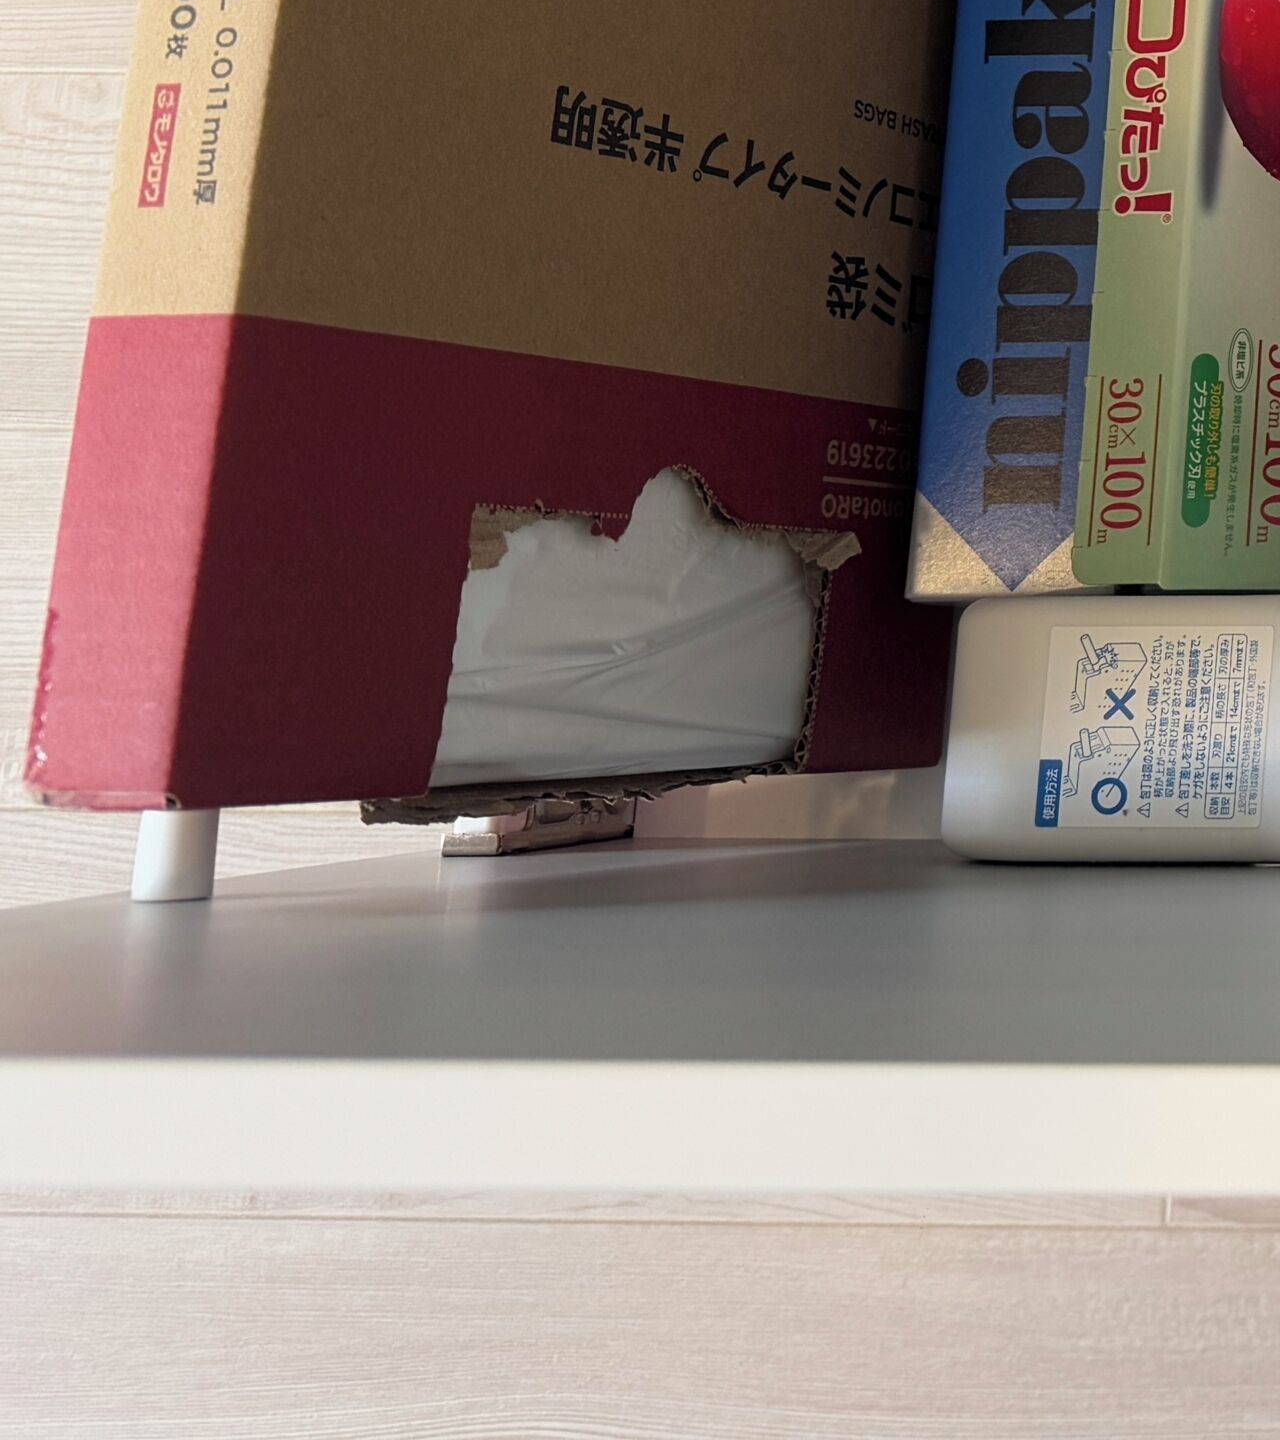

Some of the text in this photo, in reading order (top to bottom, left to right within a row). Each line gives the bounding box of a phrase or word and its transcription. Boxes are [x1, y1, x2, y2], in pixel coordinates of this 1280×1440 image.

[192, 26, 238, 206] 0.011mm厚
[550, 84, 685, 174] 半透明
[853, 100, 945, 146] RASH BAGS
[1042, 767, 1059, 820] 使用方法
